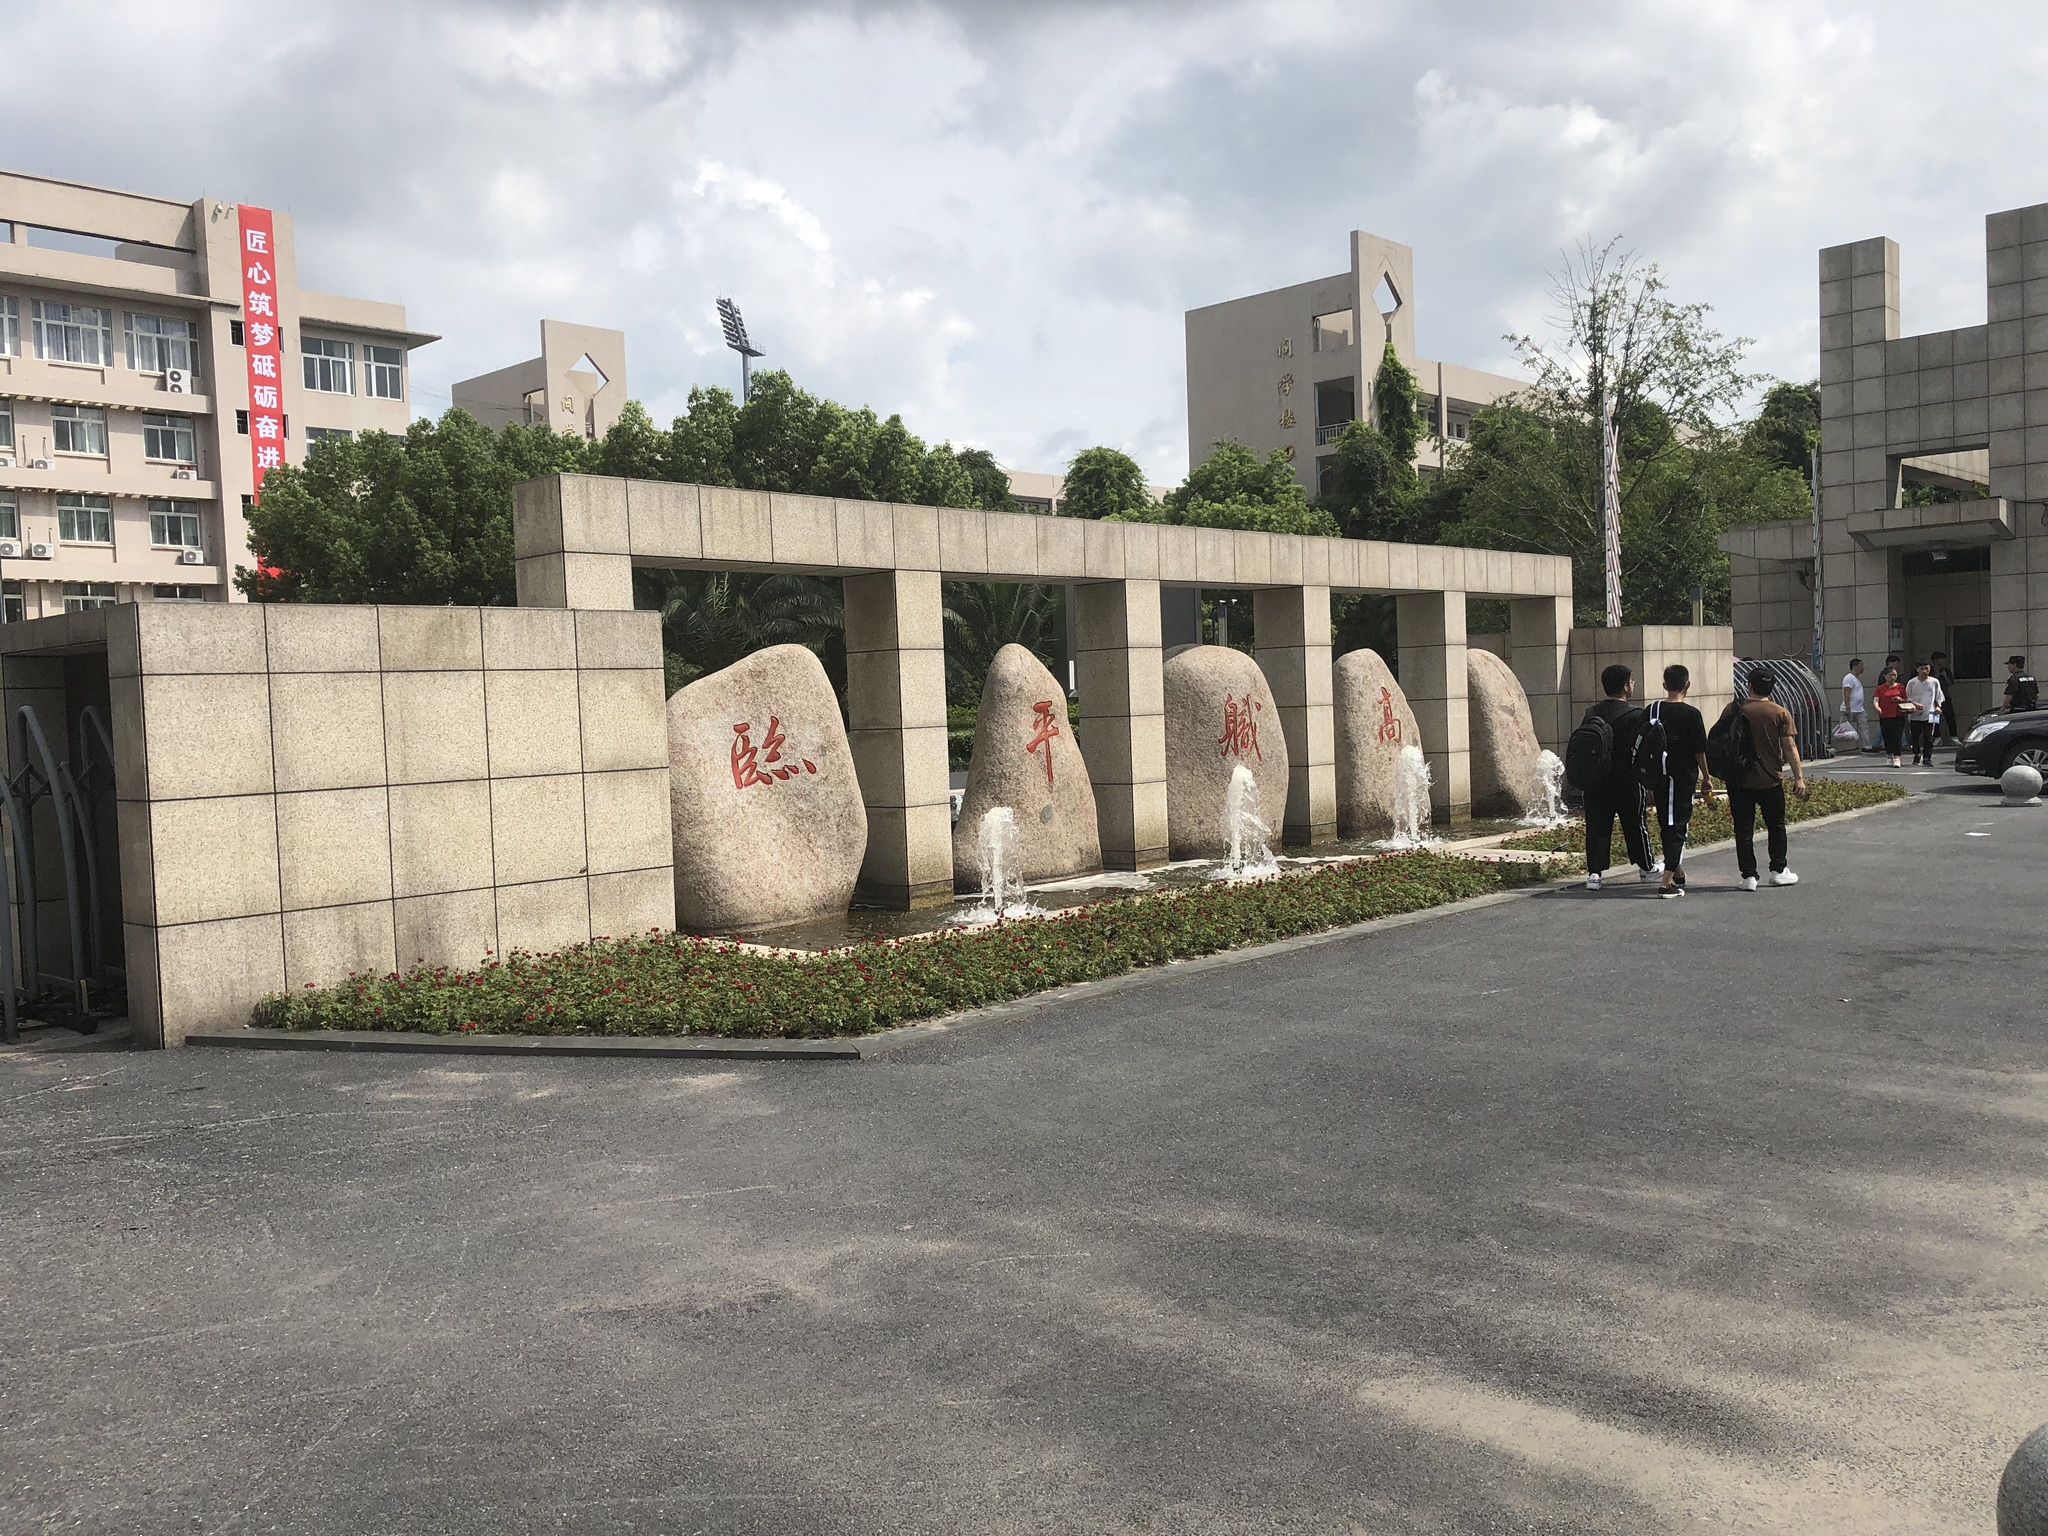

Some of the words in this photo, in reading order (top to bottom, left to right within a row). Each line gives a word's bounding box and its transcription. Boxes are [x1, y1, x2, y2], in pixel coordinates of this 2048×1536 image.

[246, 229, 280, 488] 匠心筑梦砥砺奋进
[1026, 700, 1060, 784] 平
